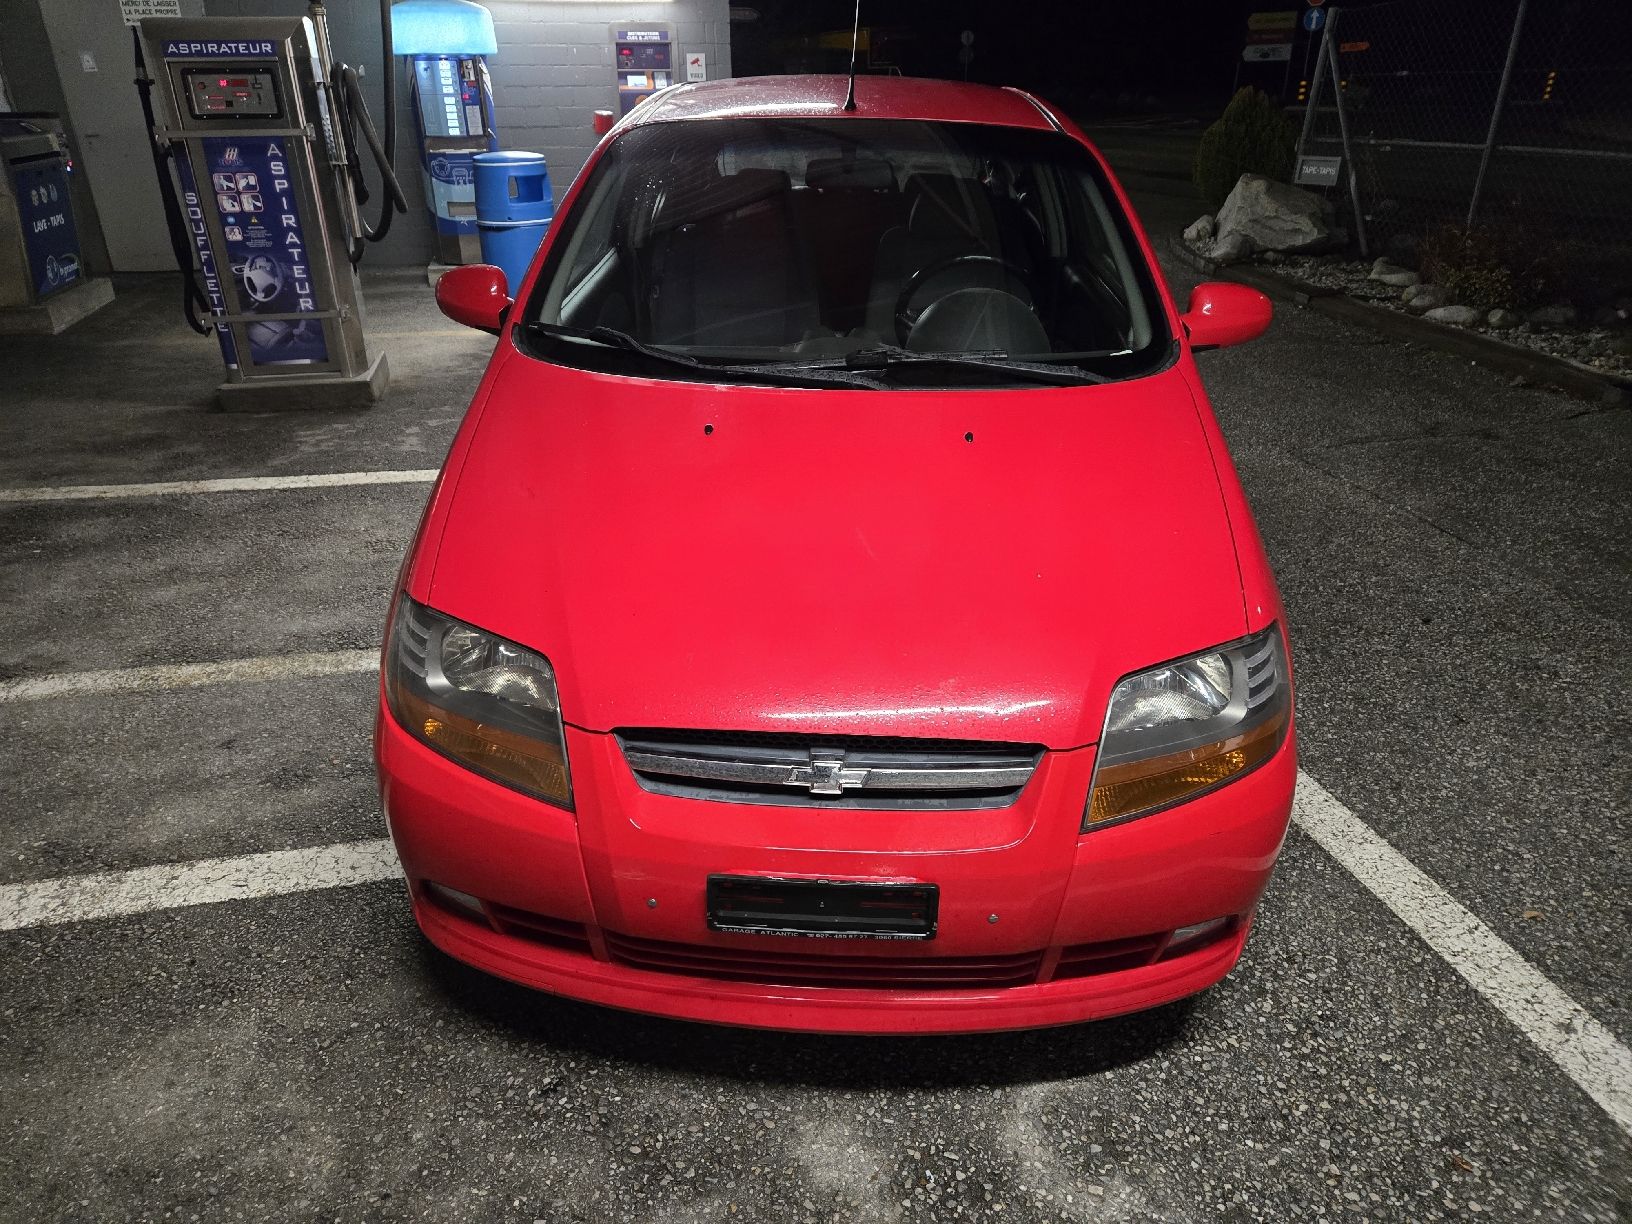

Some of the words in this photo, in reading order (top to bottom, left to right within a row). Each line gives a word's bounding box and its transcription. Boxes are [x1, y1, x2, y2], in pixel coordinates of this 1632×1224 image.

[167, 43, 273, 54] ASPIRATEUR
[1302, 166, 1337, 175] TAPE-TAPIS
[50, 213, 65, 227] TAPIS
[267, 143, 314, 311] ASPIRATEUR
[185, 192, 229, 332] SOUFFLETTE
